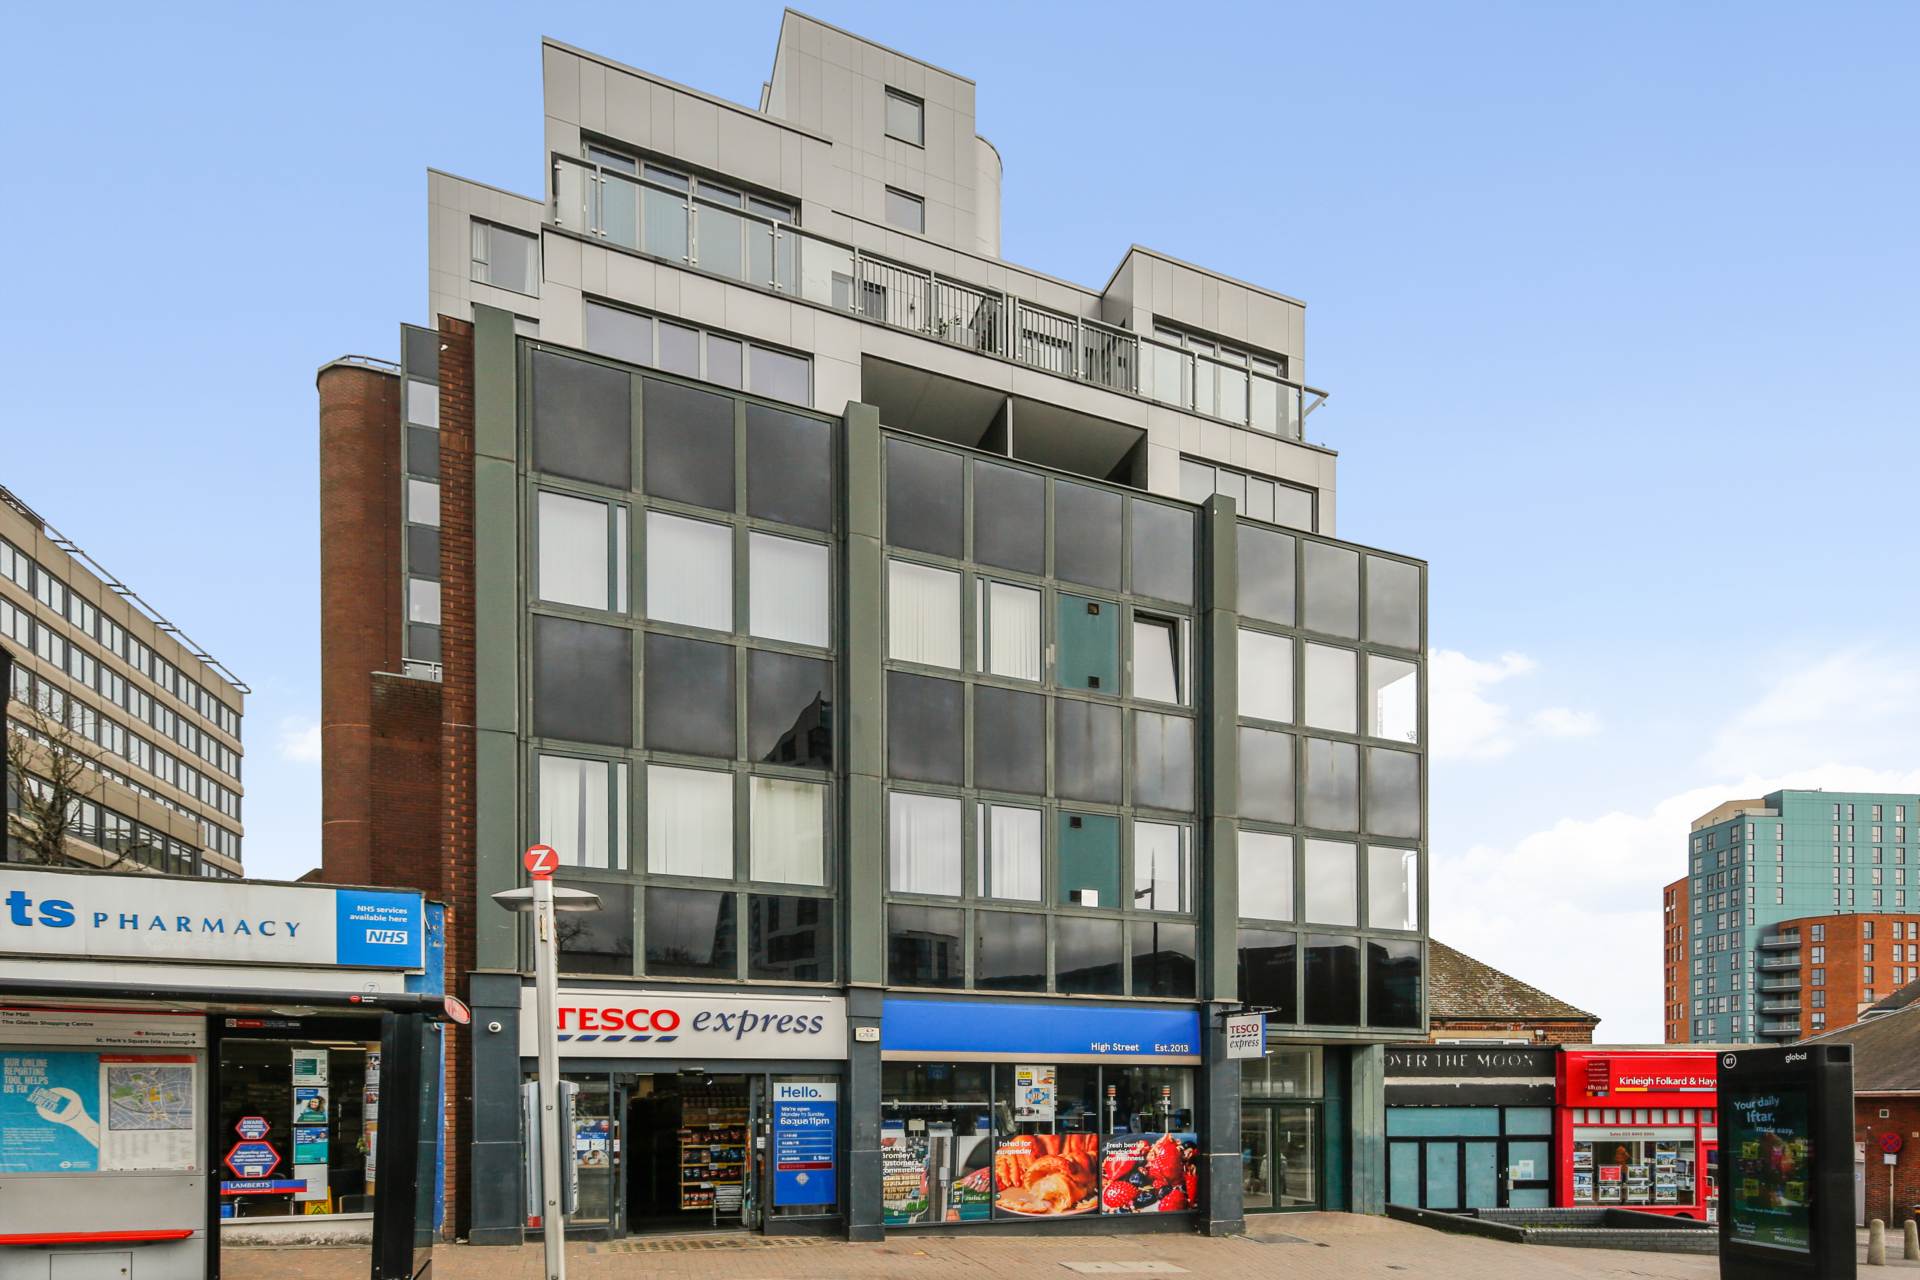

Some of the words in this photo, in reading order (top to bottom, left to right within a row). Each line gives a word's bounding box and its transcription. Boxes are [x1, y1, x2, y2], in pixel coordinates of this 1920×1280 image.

[531, 849, 551, 871] Z
[376, 906, 407, 914] services
[93, 912, 300, 937] PHARMACY
[368, 930, 405, 943] NHS
[557, 1008, 680, 1032] TESCO
[692, 1010, 824, 1040] express
[1230, 1024, 1259, 1034] TESCO
[1091, 1042, 1110, 1051] High
[1113, 1042, 1139, 1051] Street
[1230, 1038, 1260, 1050] express
[1437, 1054, 1468, 1067] THE
[1785, 1052, 1807, 1063] global
[1619, 1077, 1654, 1086] Kinleigh
[1656, 1077, 1687, 1085] Folkard
[1689, 1077, 1696, 1085] &
[781, 1086, 822, 1098] Hello.
[1734, 1101, 1756, 1110] Your
[1759, 1096, 1779, 1107] daily
[1746, 1110, 1775, 1123] Iftar,
[1777, 1127, 1794, 1135] easy.
